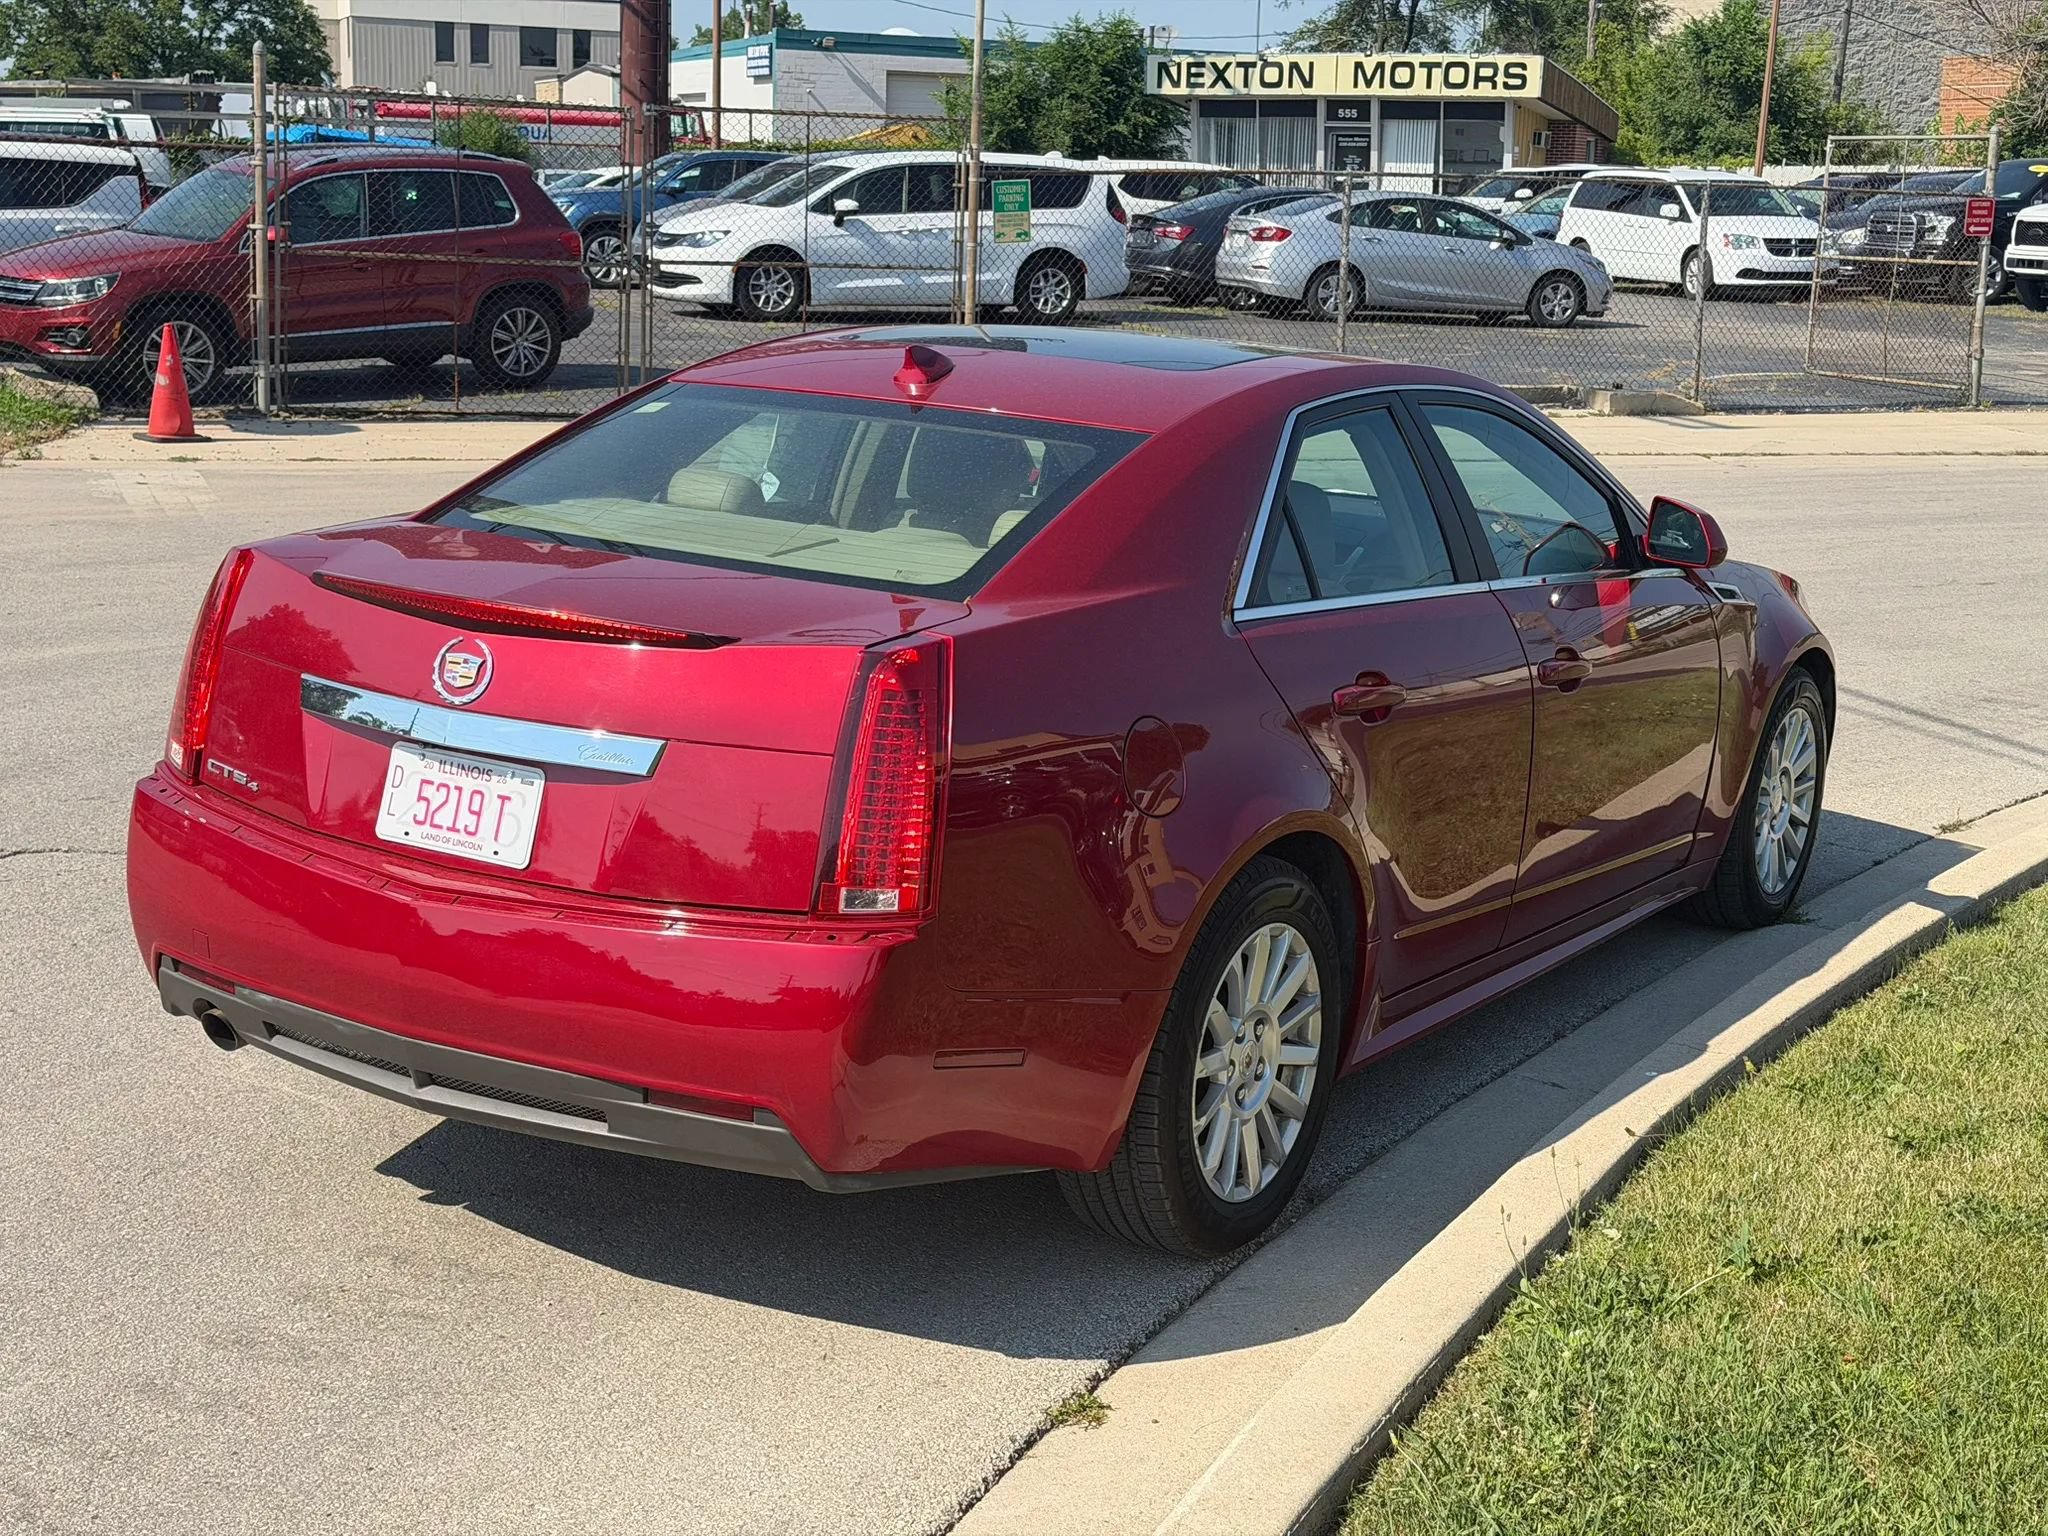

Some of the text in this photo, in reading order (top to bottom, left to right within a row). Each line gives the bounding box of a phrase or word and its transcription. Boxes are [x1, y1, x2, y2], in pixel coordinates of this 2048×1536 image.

[1156, 61, 1527, 91] NEXTON MOTORS
[1337, 108, 1358, 118] 555
[995, 184, 1026, 194] CUSTOMER
[998, 193, 1025, 203] PARKING
[1003, 203, 1020, 211] ONLY
[577, 743, 635, 765] Cadillac
[424, 759, 508, 785] 20 ILLINOIS 26
[412, 778, 485, 837] 5219
[493, 793, 512, 843] T
[420, 831, 483, 851] LAND OF LINCOLN
